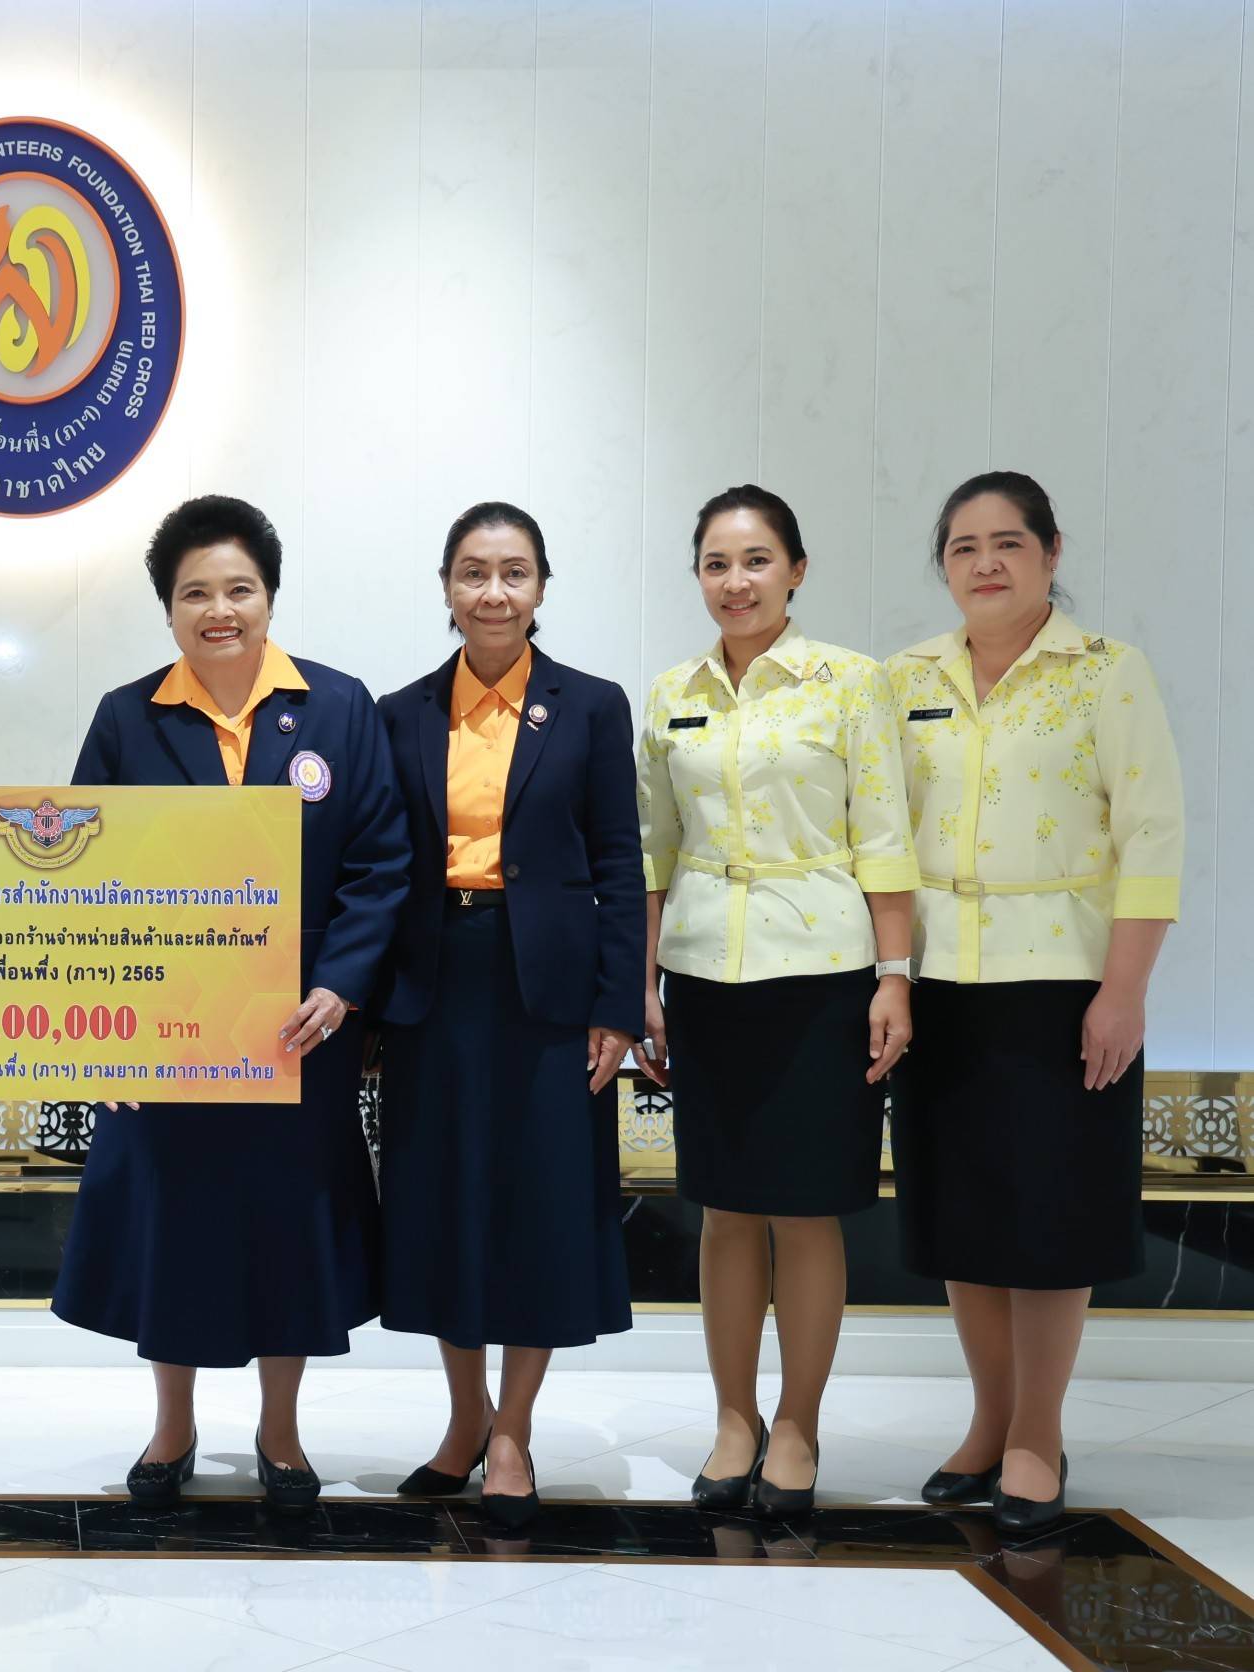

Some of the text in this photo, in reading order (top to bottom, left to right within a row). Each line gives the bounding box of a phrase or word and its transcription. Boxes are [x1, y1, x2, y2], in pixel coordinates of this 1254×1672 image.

[67, 155, 145, 257] FOUNDATION
[135, 260, 155, 304] THAI
[141, 311, 156, 350] RED
[96, 339, 135, 406] ยามยาก
[124, 356, 153, 419] CROSS
[66, 964, 116, 985] (ภาฯ)
[122, 964, 166, 982] 2565
[157, 1021, 201, 1040] บาท
[32, 1062, 78, 1082] (ภาฯ)
[83, 1063, 148, 1080] ยามยาก
[154, 1056, 276, 1081] สภากาชาดไทย
